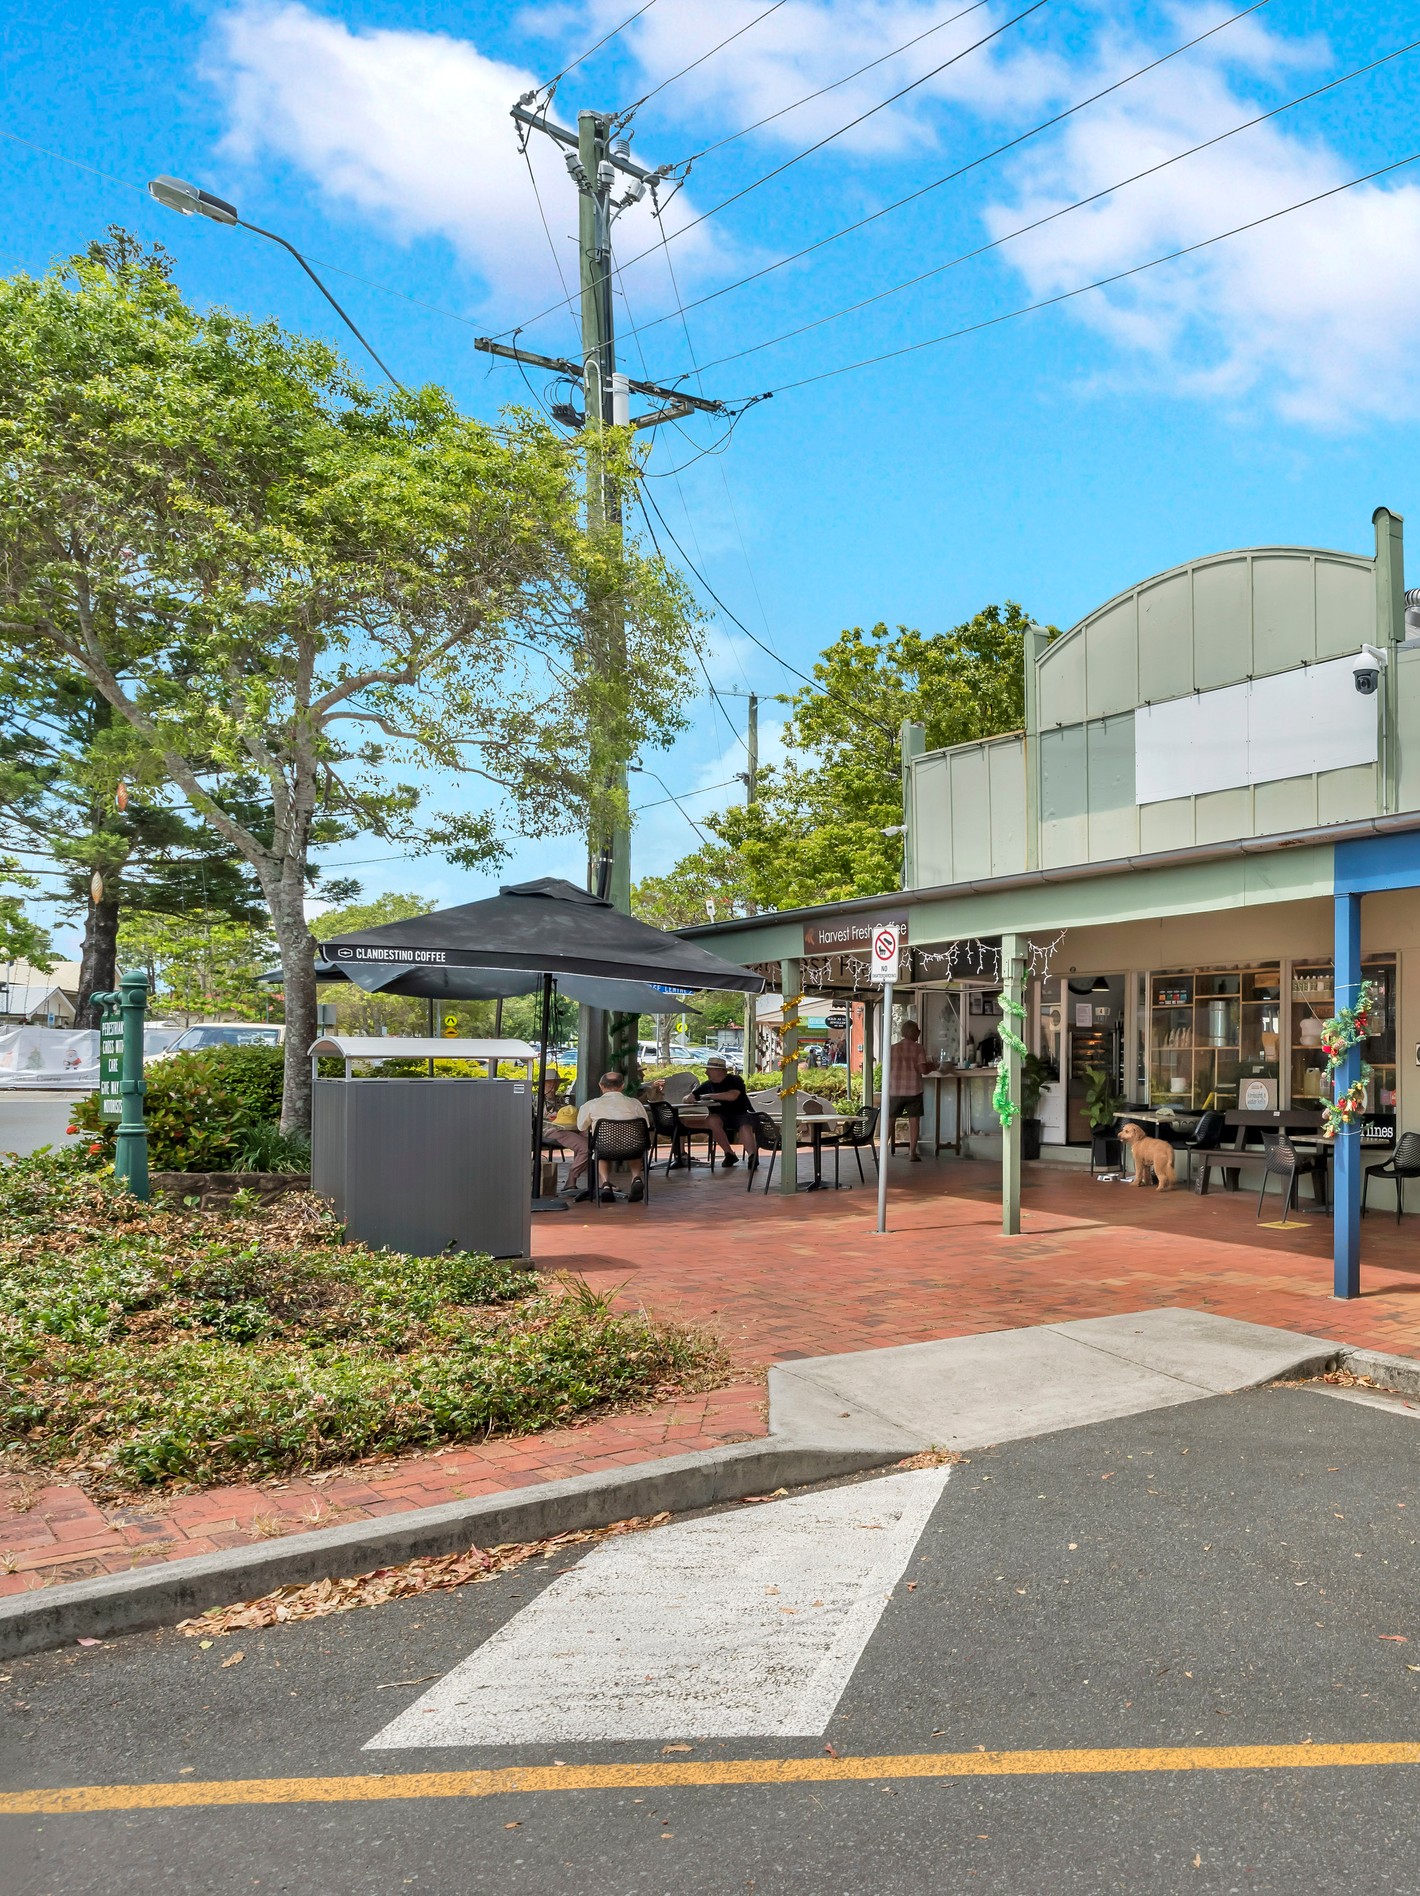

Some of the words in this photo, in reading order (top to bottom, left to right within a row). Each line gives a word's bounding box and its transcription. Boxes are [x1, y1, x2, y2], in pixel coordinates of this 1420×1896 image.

[818, 926, 850, 944] Harvest
[851, 924, 873, 940] Fresh
[356, 948, 413, 961] CLANDESTINO
[415, 950, 446, 962] COFFEE
